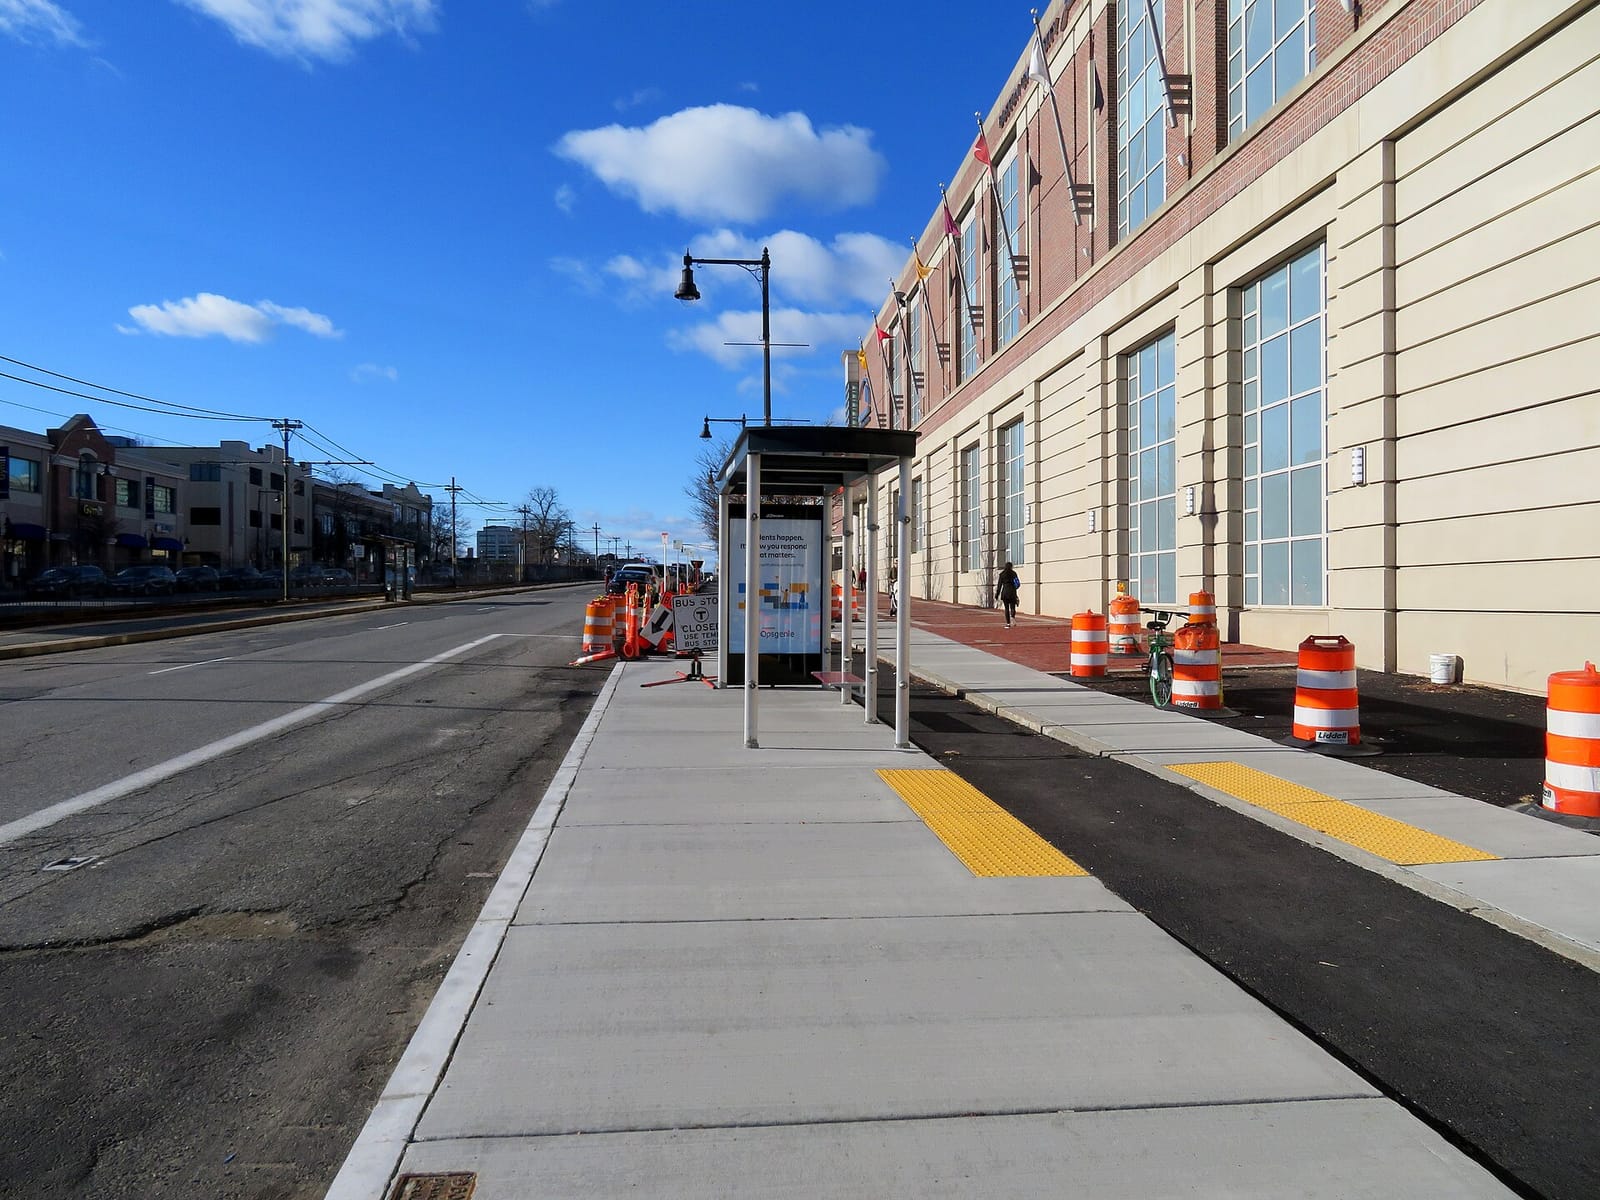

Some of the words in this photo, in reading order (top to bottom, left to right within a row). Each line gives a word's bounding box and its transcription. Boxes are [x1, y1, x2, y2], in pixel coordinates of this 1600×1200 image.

[777, 534, 804, 542] happen.
[675, 599, 695, 608] BUS
[700, 597, 718, 606] STO
[760, 630, 795, 638] Opsgenie
[1318, 731, 1347, 739] Liddell
